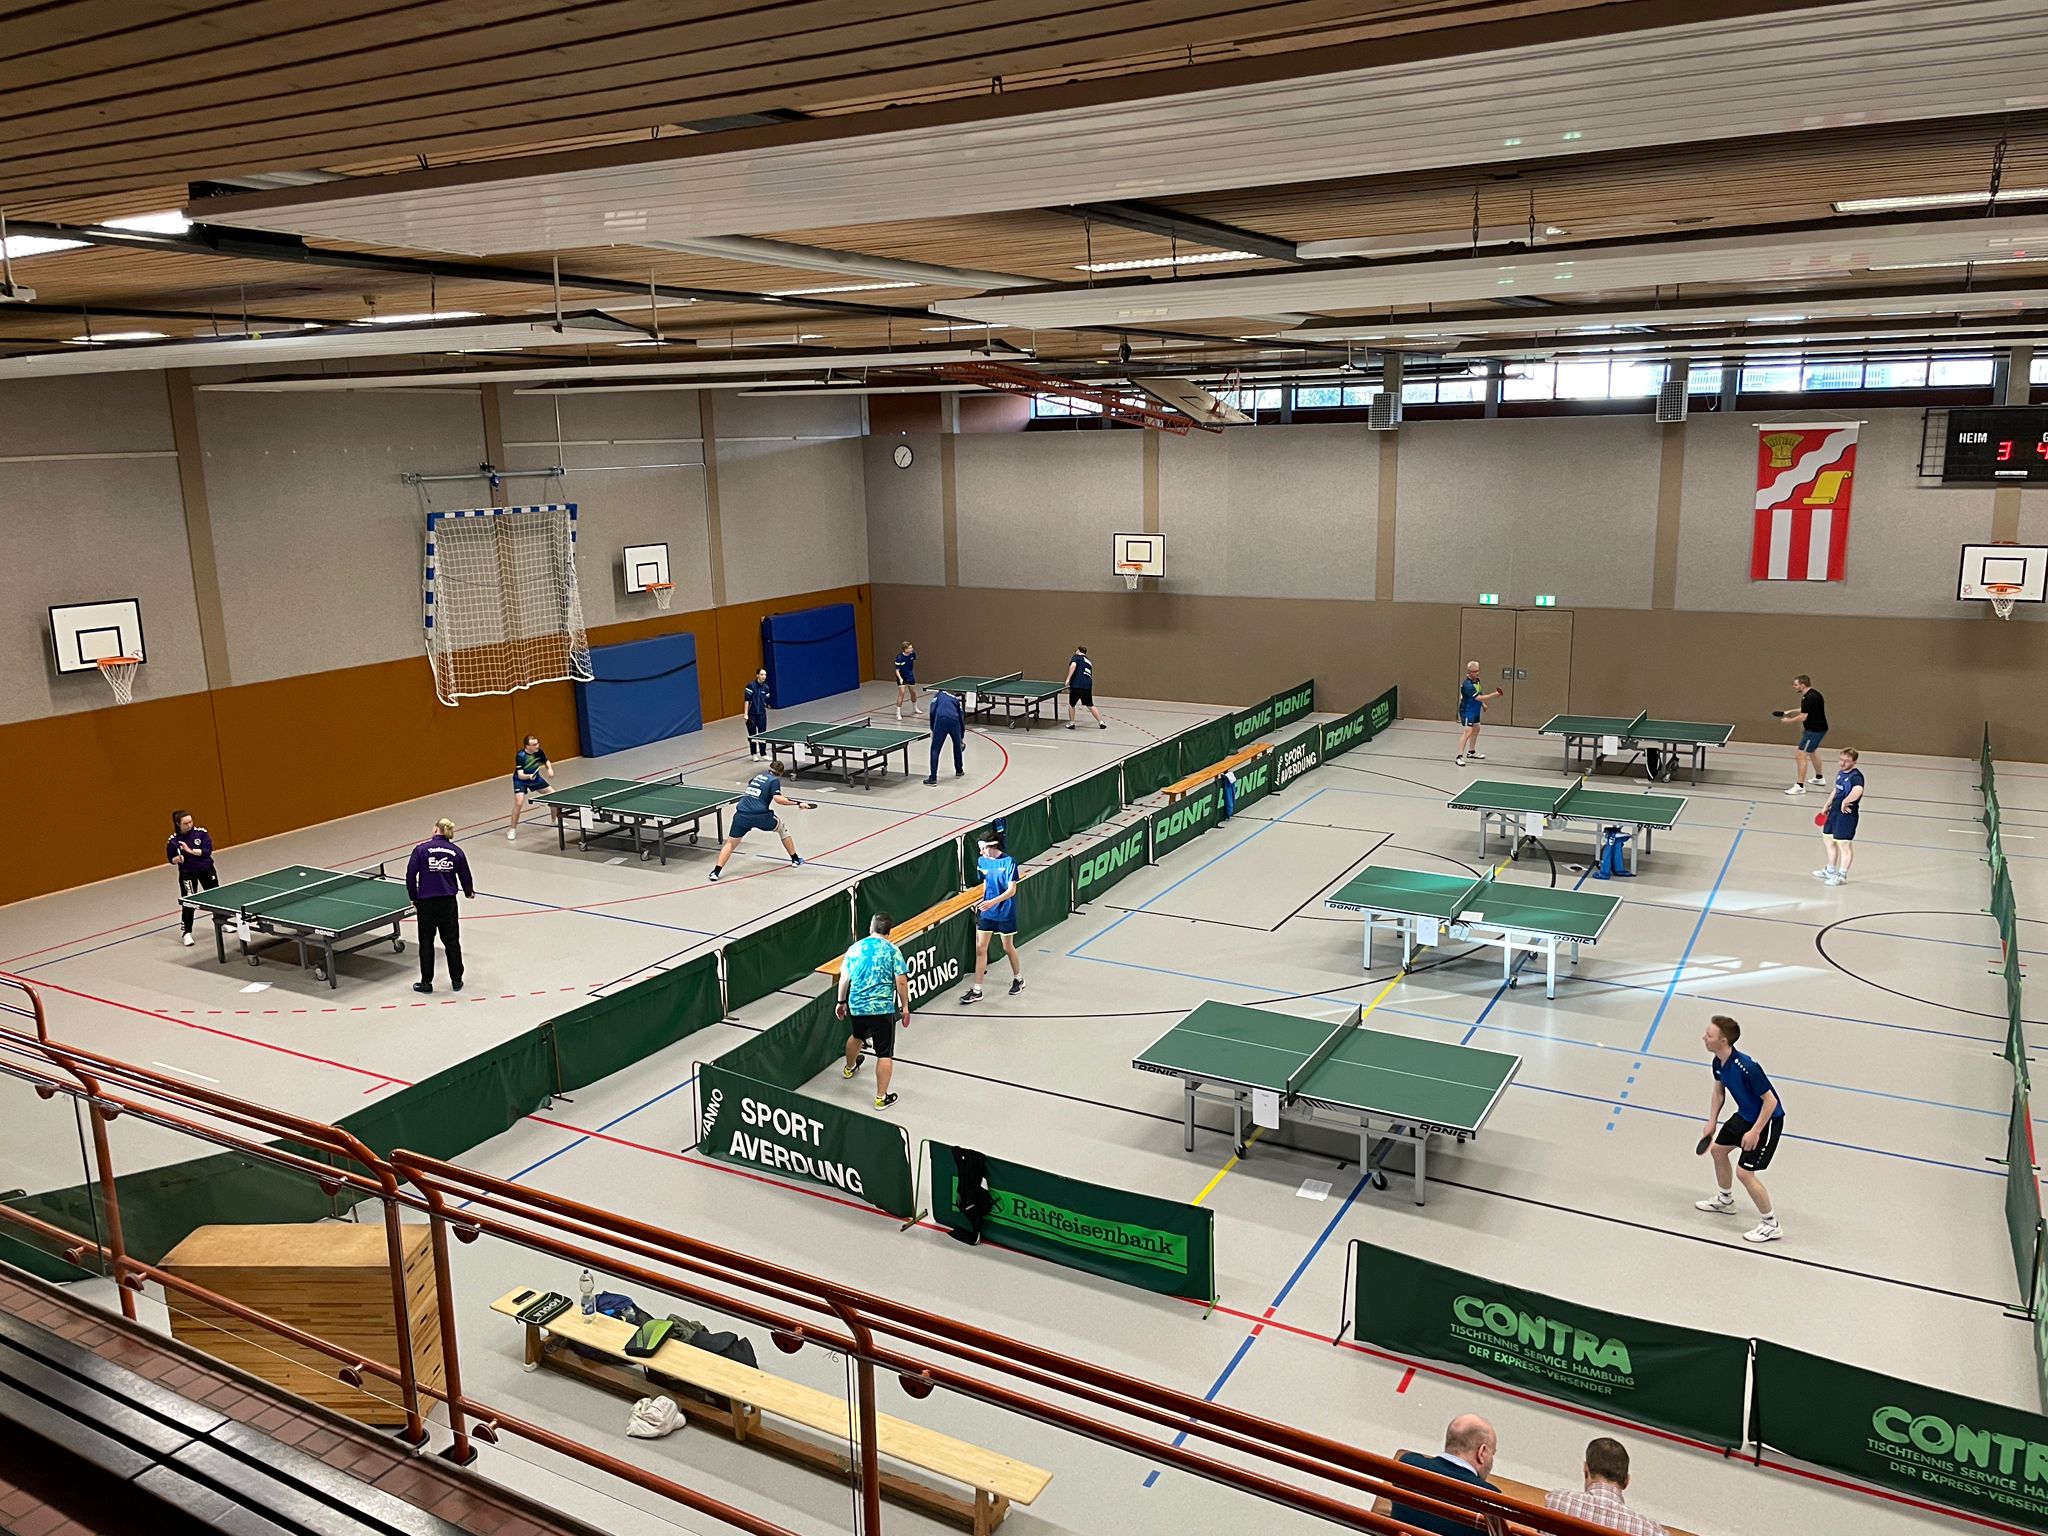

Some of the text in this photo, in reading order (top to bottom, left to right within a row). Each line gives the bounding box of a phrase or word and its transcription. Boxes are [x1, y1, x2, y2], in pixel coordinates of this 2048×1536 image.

[1959, 432, 1988, 443] HEIM
[1997, 441, 2012, 461] 3
[1275, 688, 1312, 719] DONIC
[1234, 706, 1272, 740] DONIC
[1325, 714, 1365, 751] DONIC
[1281, 751, 1317, 784] AVERDUNG
[1284, 743, 1306, 767] SPORT
[1155, 794, 1213, 844] DONIC
[1078, 830, 1143, 890] DONIC
[1330, 903, 1361, 912] DONIC
[1553, 935, 1590, 945] DONIC
[907, 946, 937, 978] ORT
[1138, 1064, 1178, 1078] DONIC
[741, 1097, 824, 1147] SPORT
[1420, 1123, 1468, 1139] DONIC
[729, 1130, 865, 1195] AVERDUNG
[1011, 1197, 1175, 1257] Raiffeisenbank
[1453, 1295, 1632, 1374] CONTRA
[1450, 1323, 1635, 1386] TISCHTENNIS SERVICE HAMBURG
[1468, 1344, 1612, 1395] DER EXPRESS-VERSENDER
[1867, 1438, 2048, 1500] TISCHTENNIS SERVICE HA
[1890, 1461, 1916, 1477] DER
